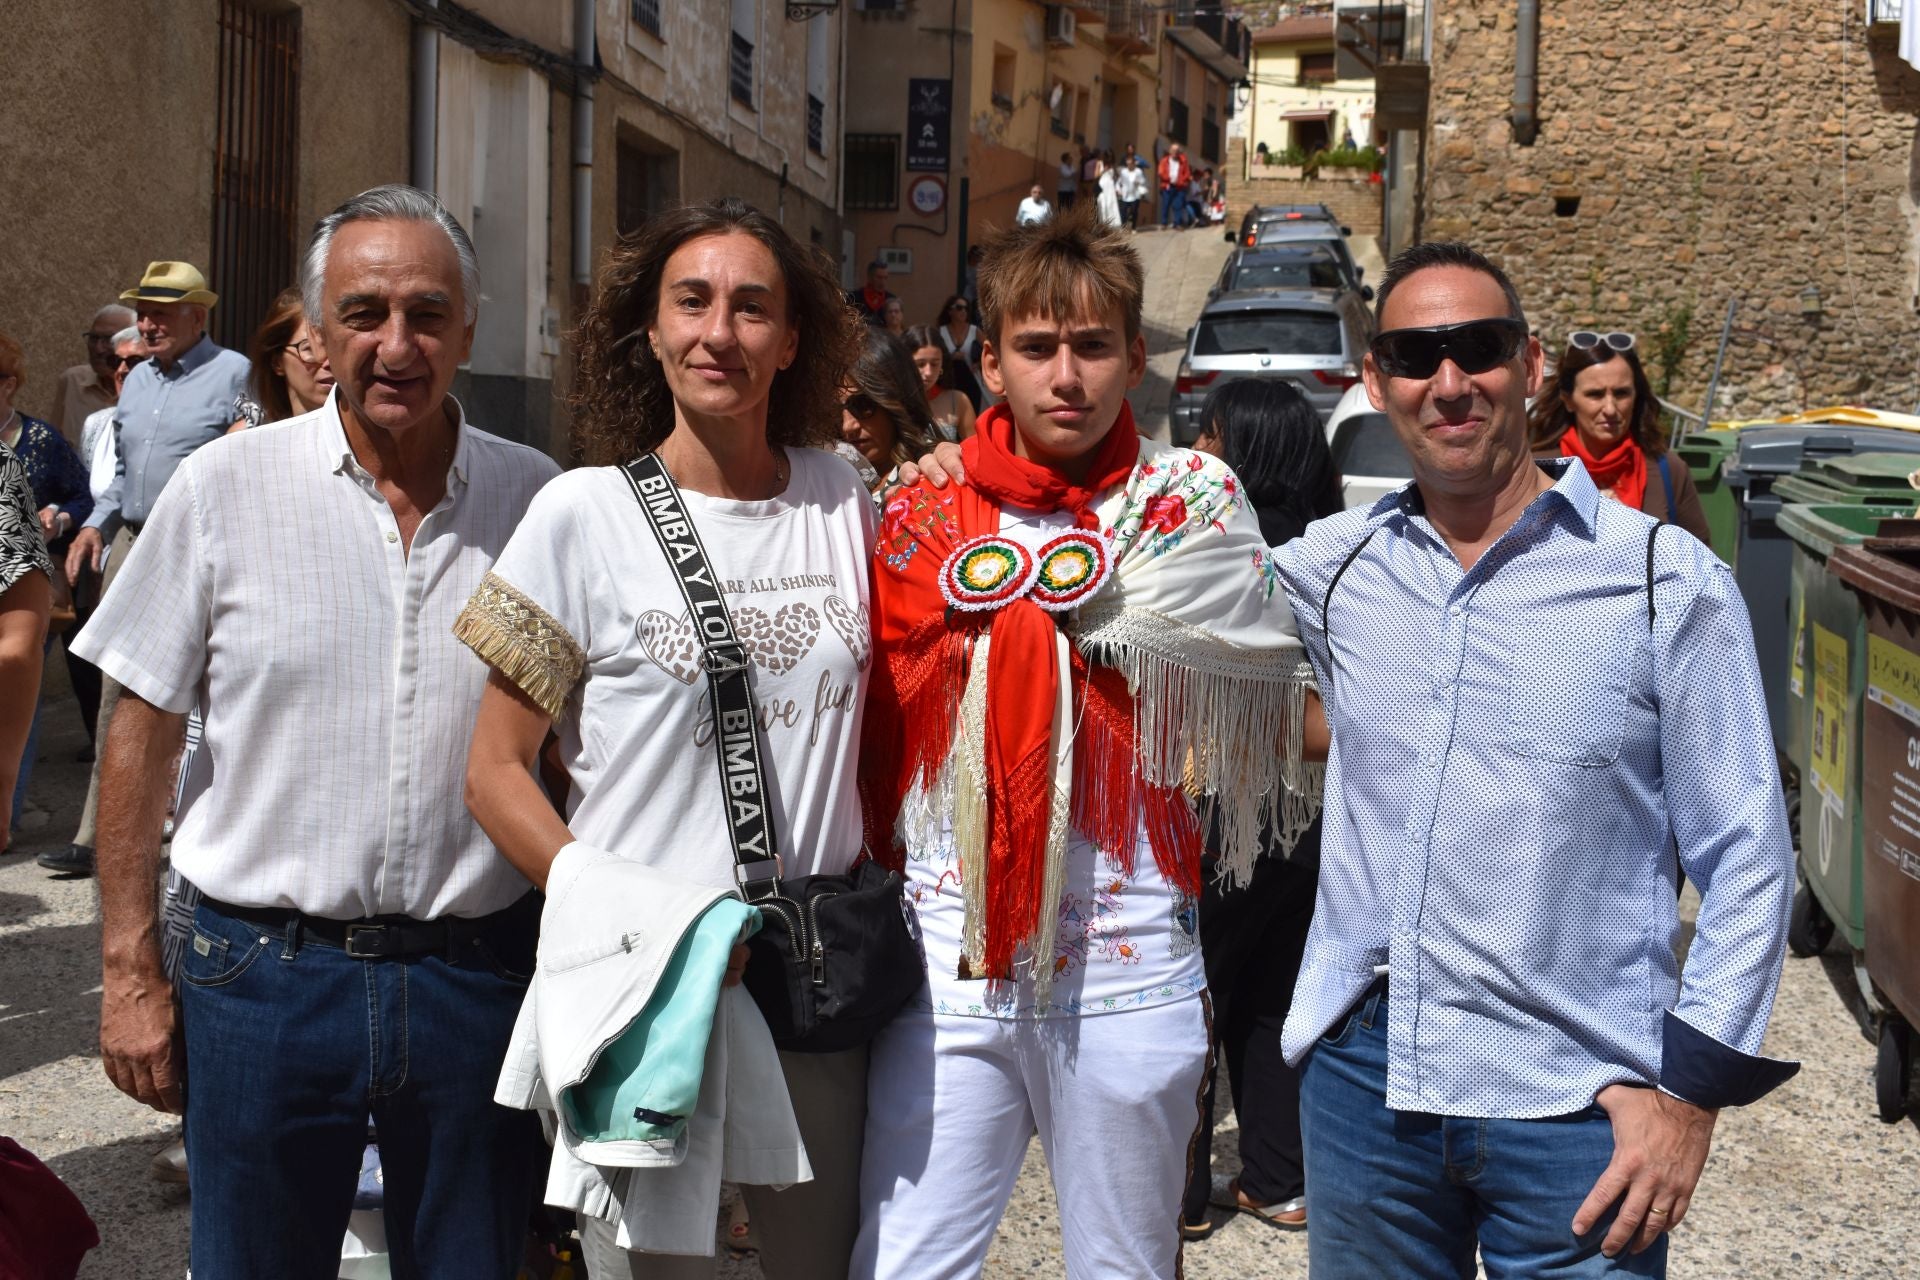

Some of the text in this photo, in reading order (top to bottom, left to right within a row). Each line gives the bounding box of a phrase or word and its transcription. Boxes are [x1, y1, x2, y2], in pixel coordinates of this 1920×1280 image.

[638, 474, 699, 564] BIMBA
[684, 566, 713, 587] Y
[750, 577, 778, 593] ALL
[780, 574, 837, 590] SHINING
[811, 669, 856, 746] fun
[722, 708, 766, 857] BIMBA Y
